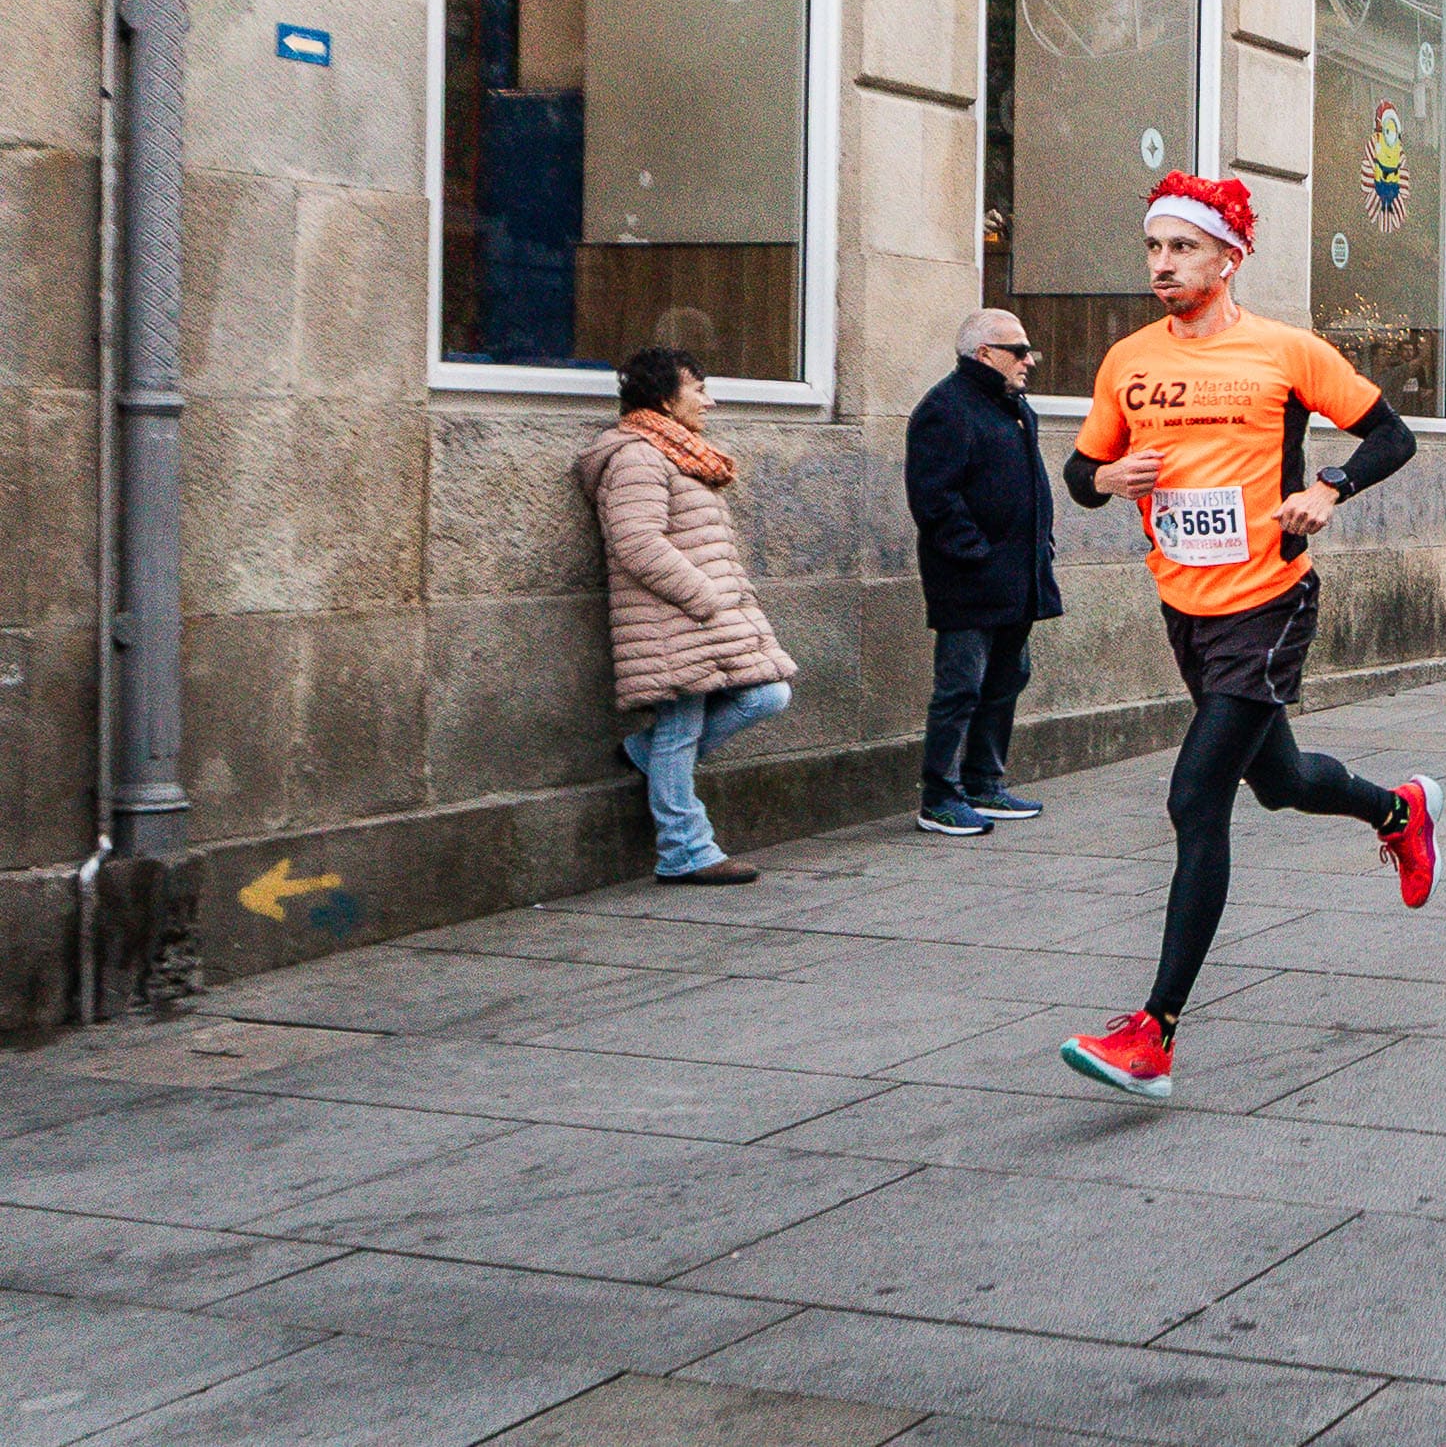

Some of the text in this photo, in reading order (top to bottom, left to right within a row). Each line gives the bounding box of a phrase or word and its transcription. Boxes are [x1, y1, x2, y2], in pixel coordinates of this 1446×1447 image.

[1192, 379, 1260, 393] Maratón
[1188, 490, 1238, 507] SILVESTRE
[1181, 508, 1237, 536] 5651
[1181, 538, 1223, 550] PONTEVEDRA
